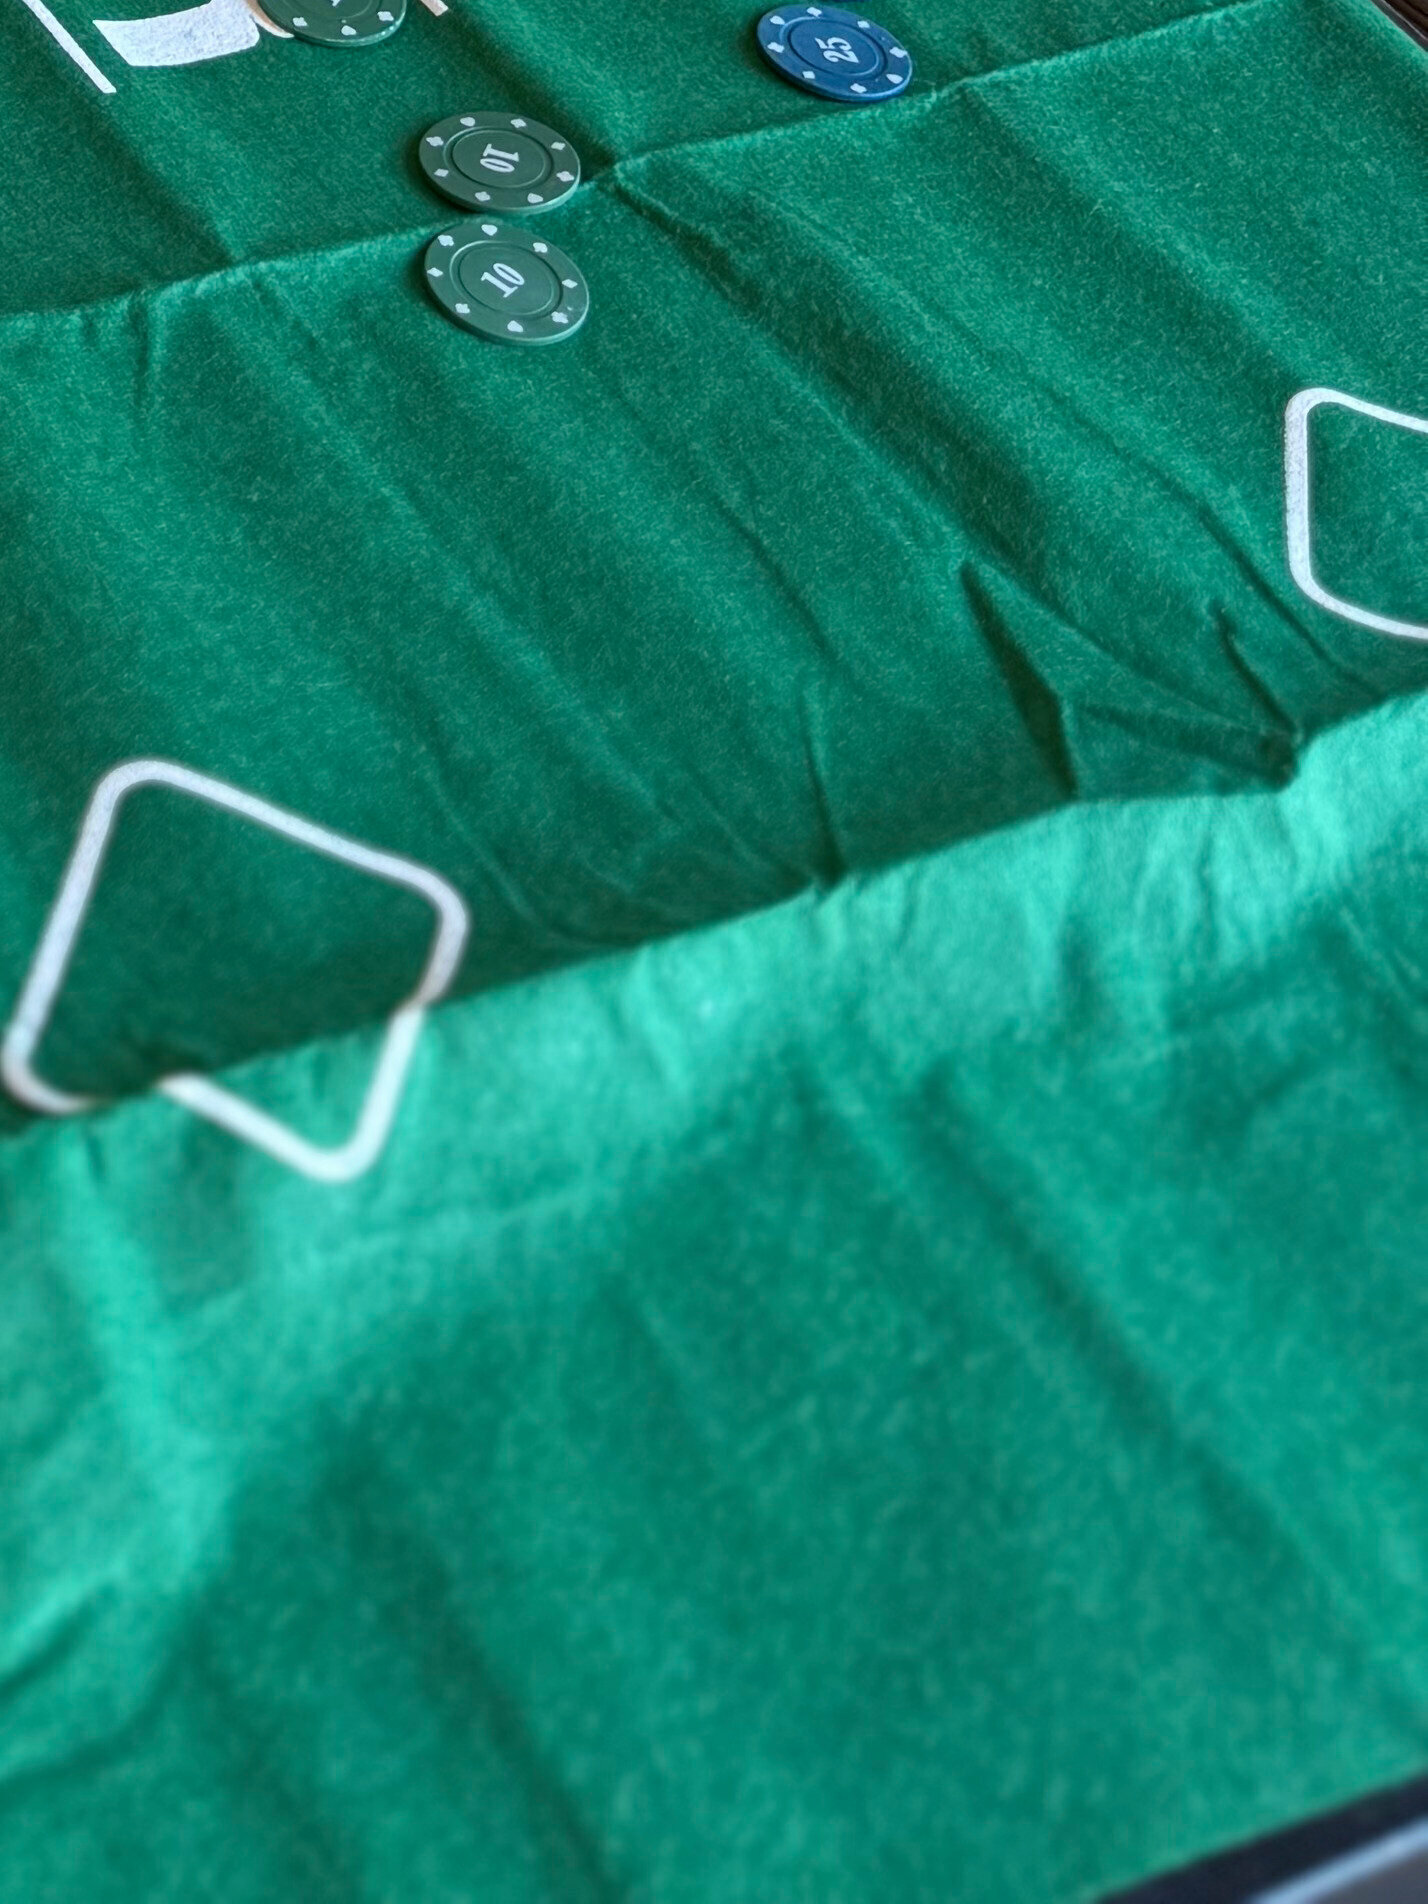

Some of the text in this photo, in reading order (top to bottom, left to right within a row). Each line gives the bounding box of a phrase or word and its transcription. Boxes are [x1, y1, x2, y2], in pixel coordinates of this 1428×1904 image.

[815, 36, 862, 64] 25
[479, 143, 521, 174] 10
[480, 262, 526, 298] 10
